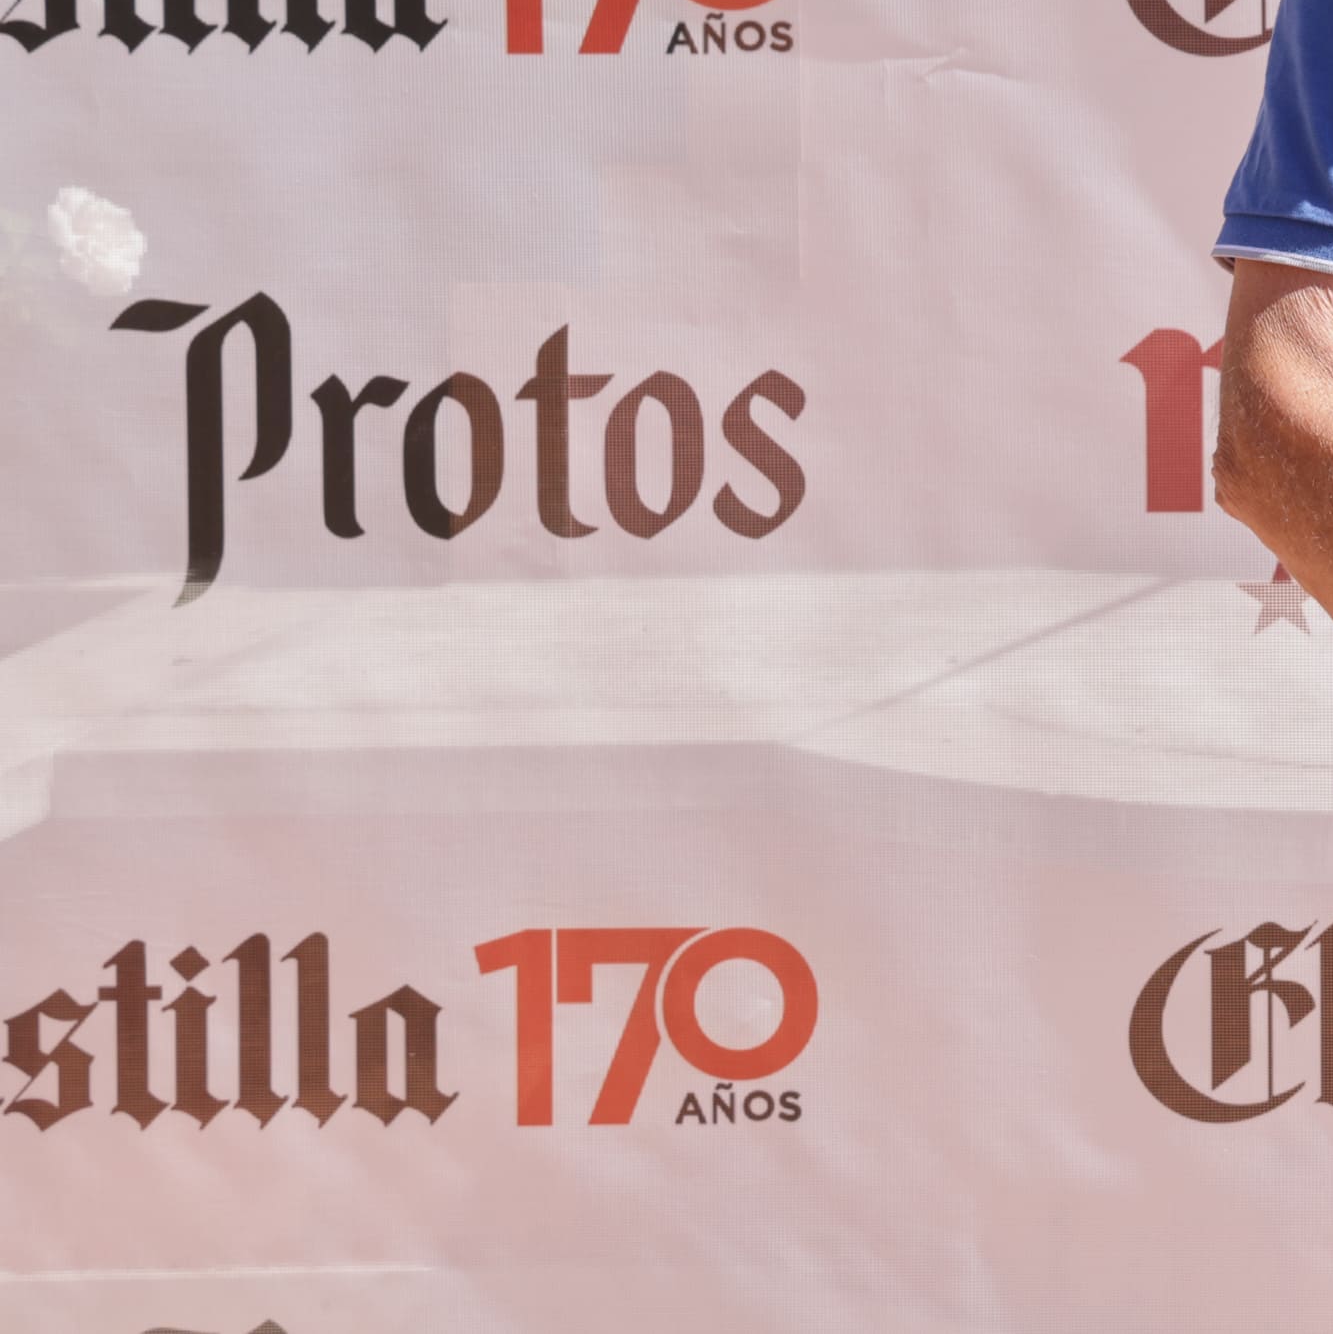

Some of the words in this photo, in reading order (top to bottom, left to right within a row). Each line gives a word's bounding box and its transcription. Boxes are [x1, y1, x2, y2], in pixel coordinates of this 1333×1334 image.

[666, 12, 793, 54] AÑOS
[109, 291, 806, 608] Protos
[3, 932, 459, 1132] stilla
[474, 927, 818, 1127] 170
[675, 1082, 802, 1125] AÑOS
